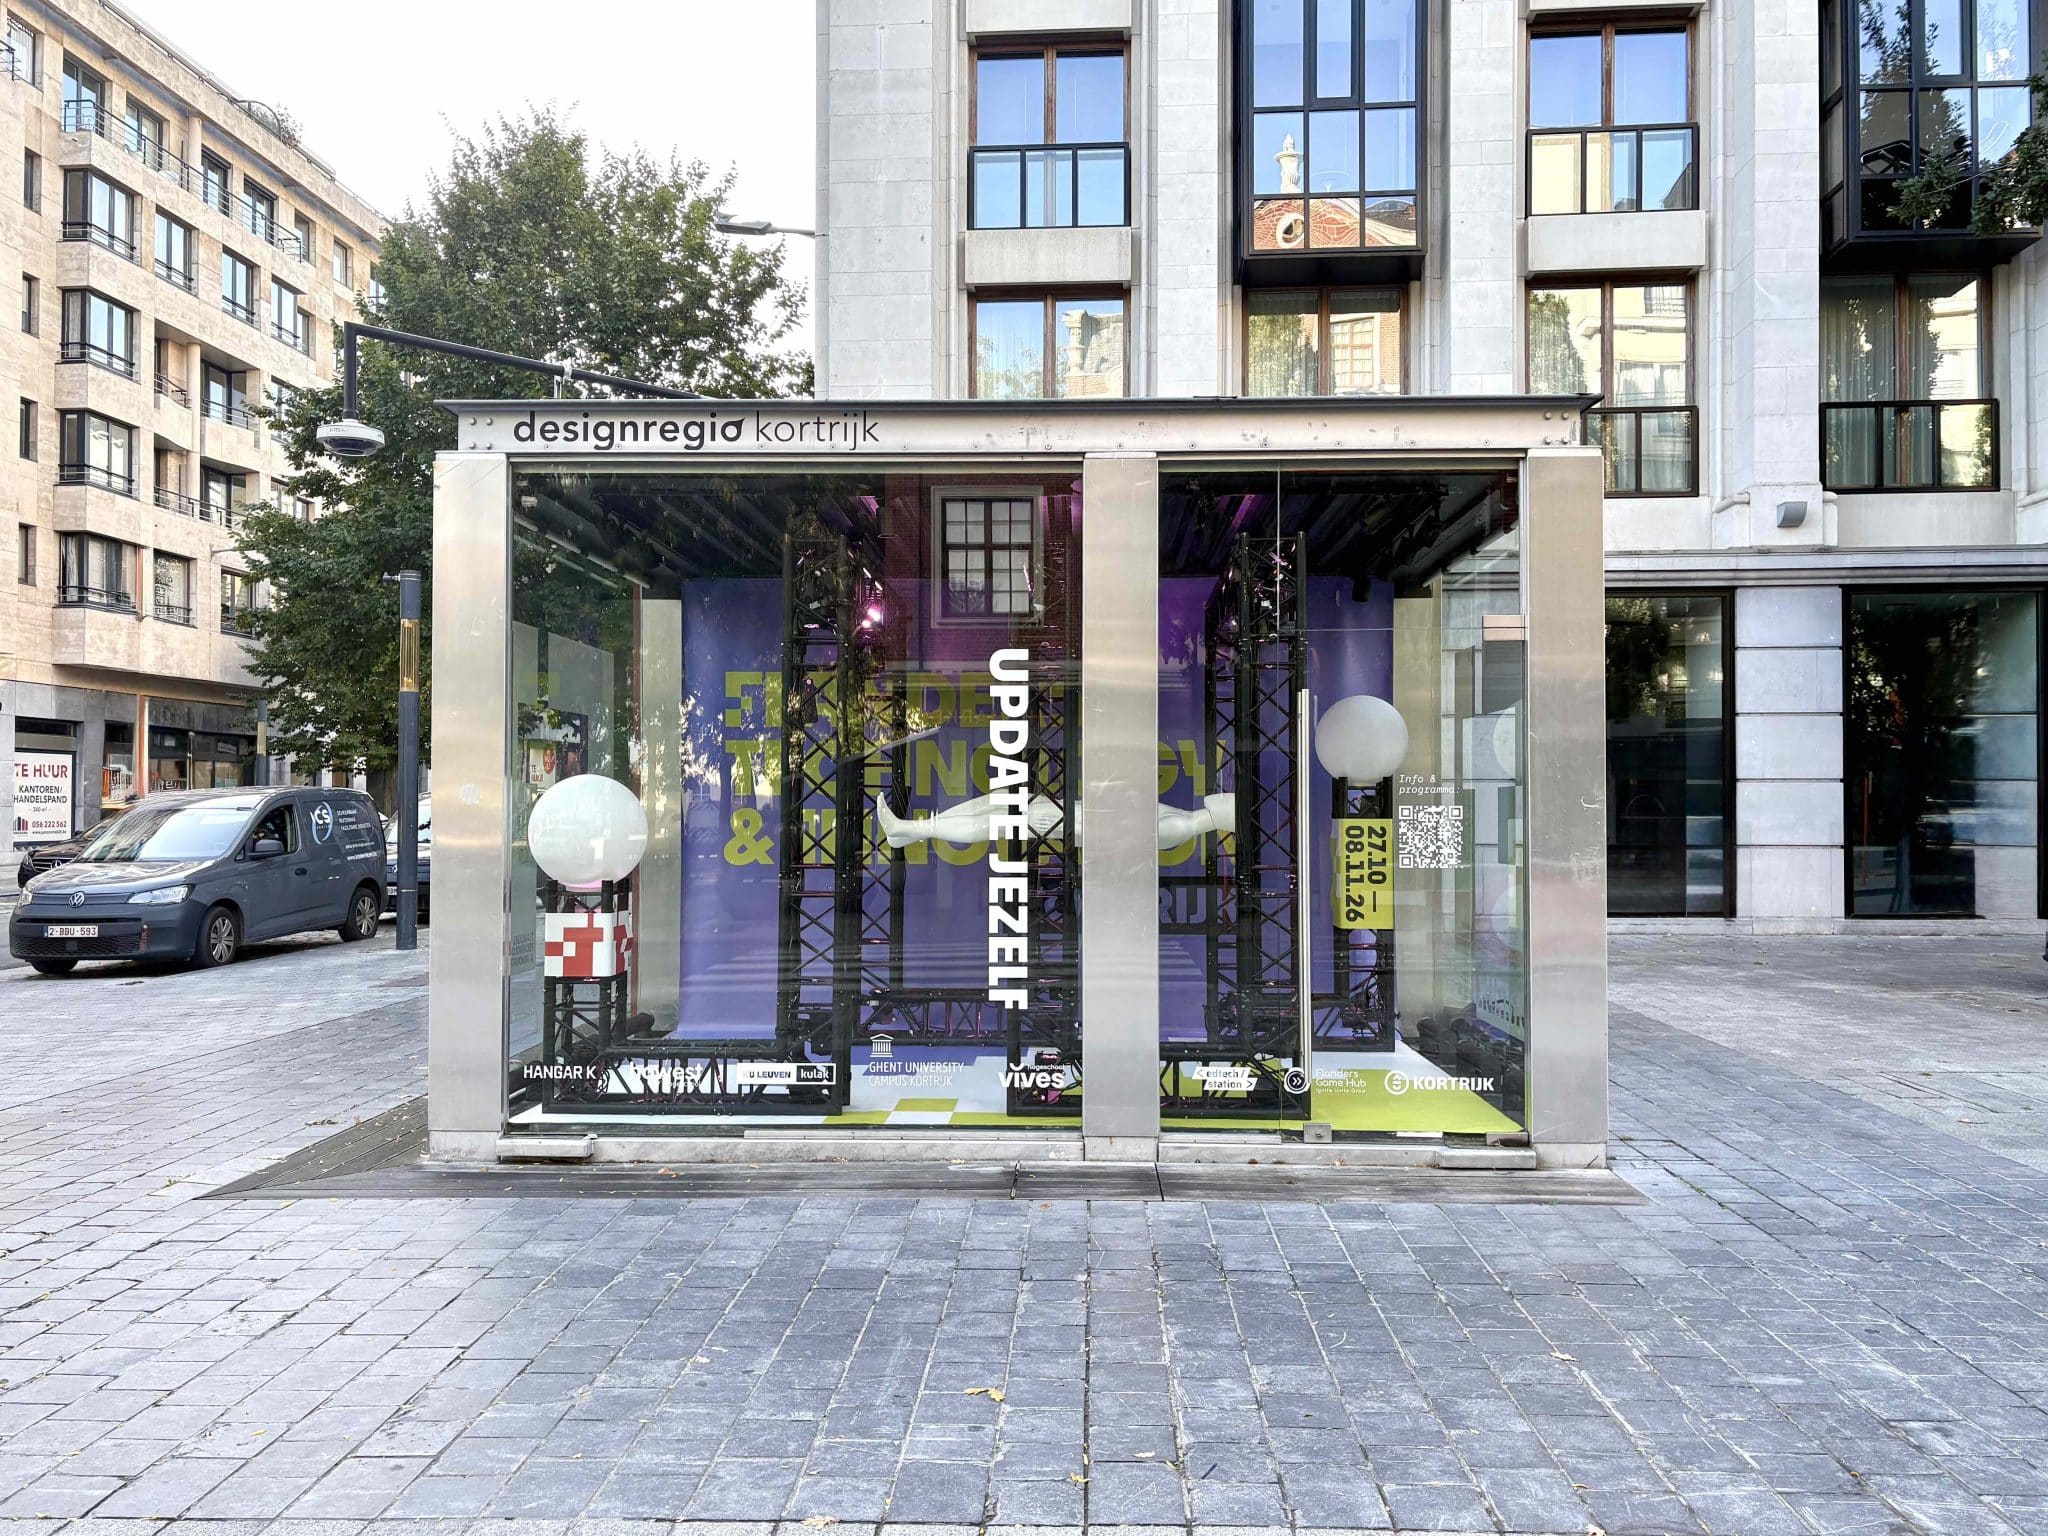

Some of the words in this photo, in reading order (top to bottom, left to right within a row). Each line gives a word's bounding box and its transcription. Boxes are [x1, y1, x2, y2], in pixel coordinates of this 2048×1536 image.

[513, 411, 745, 451] designregio
[756, 410, 880, 451] kortrijk
[725, 672, 1083, 728] FLANDE
[988, 648, 1029, 840] UPDATE
[14, 763, 29, 778] TE
[33, 763, 68, 779] HUUR
[1399, 775, 1424, 785] Info
[1429, 774, 1436, 783] &
[1398, 786, 1460, 796] programma:
[13, 795, 68, 804] HANDELSPAND
[32, 820, 43, 829] 056
[44, 820, 55, 829] 222
[724, 808, 775, 867] &
[1367, 825, 1387, 885] 27.10
[1345, 825, 1365, 922] 08.11.26
[49, 927, 97, 936] 2-BBU-593
[988, 853, 1029, 1010] JEZELF
[523, 1065, 583, 1079] HANGAR
[586, 1065, 597, 1079] K
[869, 1061, 903, 1073] GHENT
[905, 1061, 965, 1073] UNIVERSITY
[757, 1071, 791, 1079] LEUVEN
[800, 1068, 829, 1079] kulak
[998, 1070, 1065, 1089] vives
[1315, 1068, 1359, 1079] Flanders
[869, 1075, 907, 1087] CAMPUS
[910, 1075, 953, 1087] KORTRIJK
[1208, 1079, 1242, 1089] station
[1315, 1078, 1344, 1087] Game
[1345, 1078, 1367, 1088] Hub
[1413, 1076, 1495, 1091] KORTRIJK
